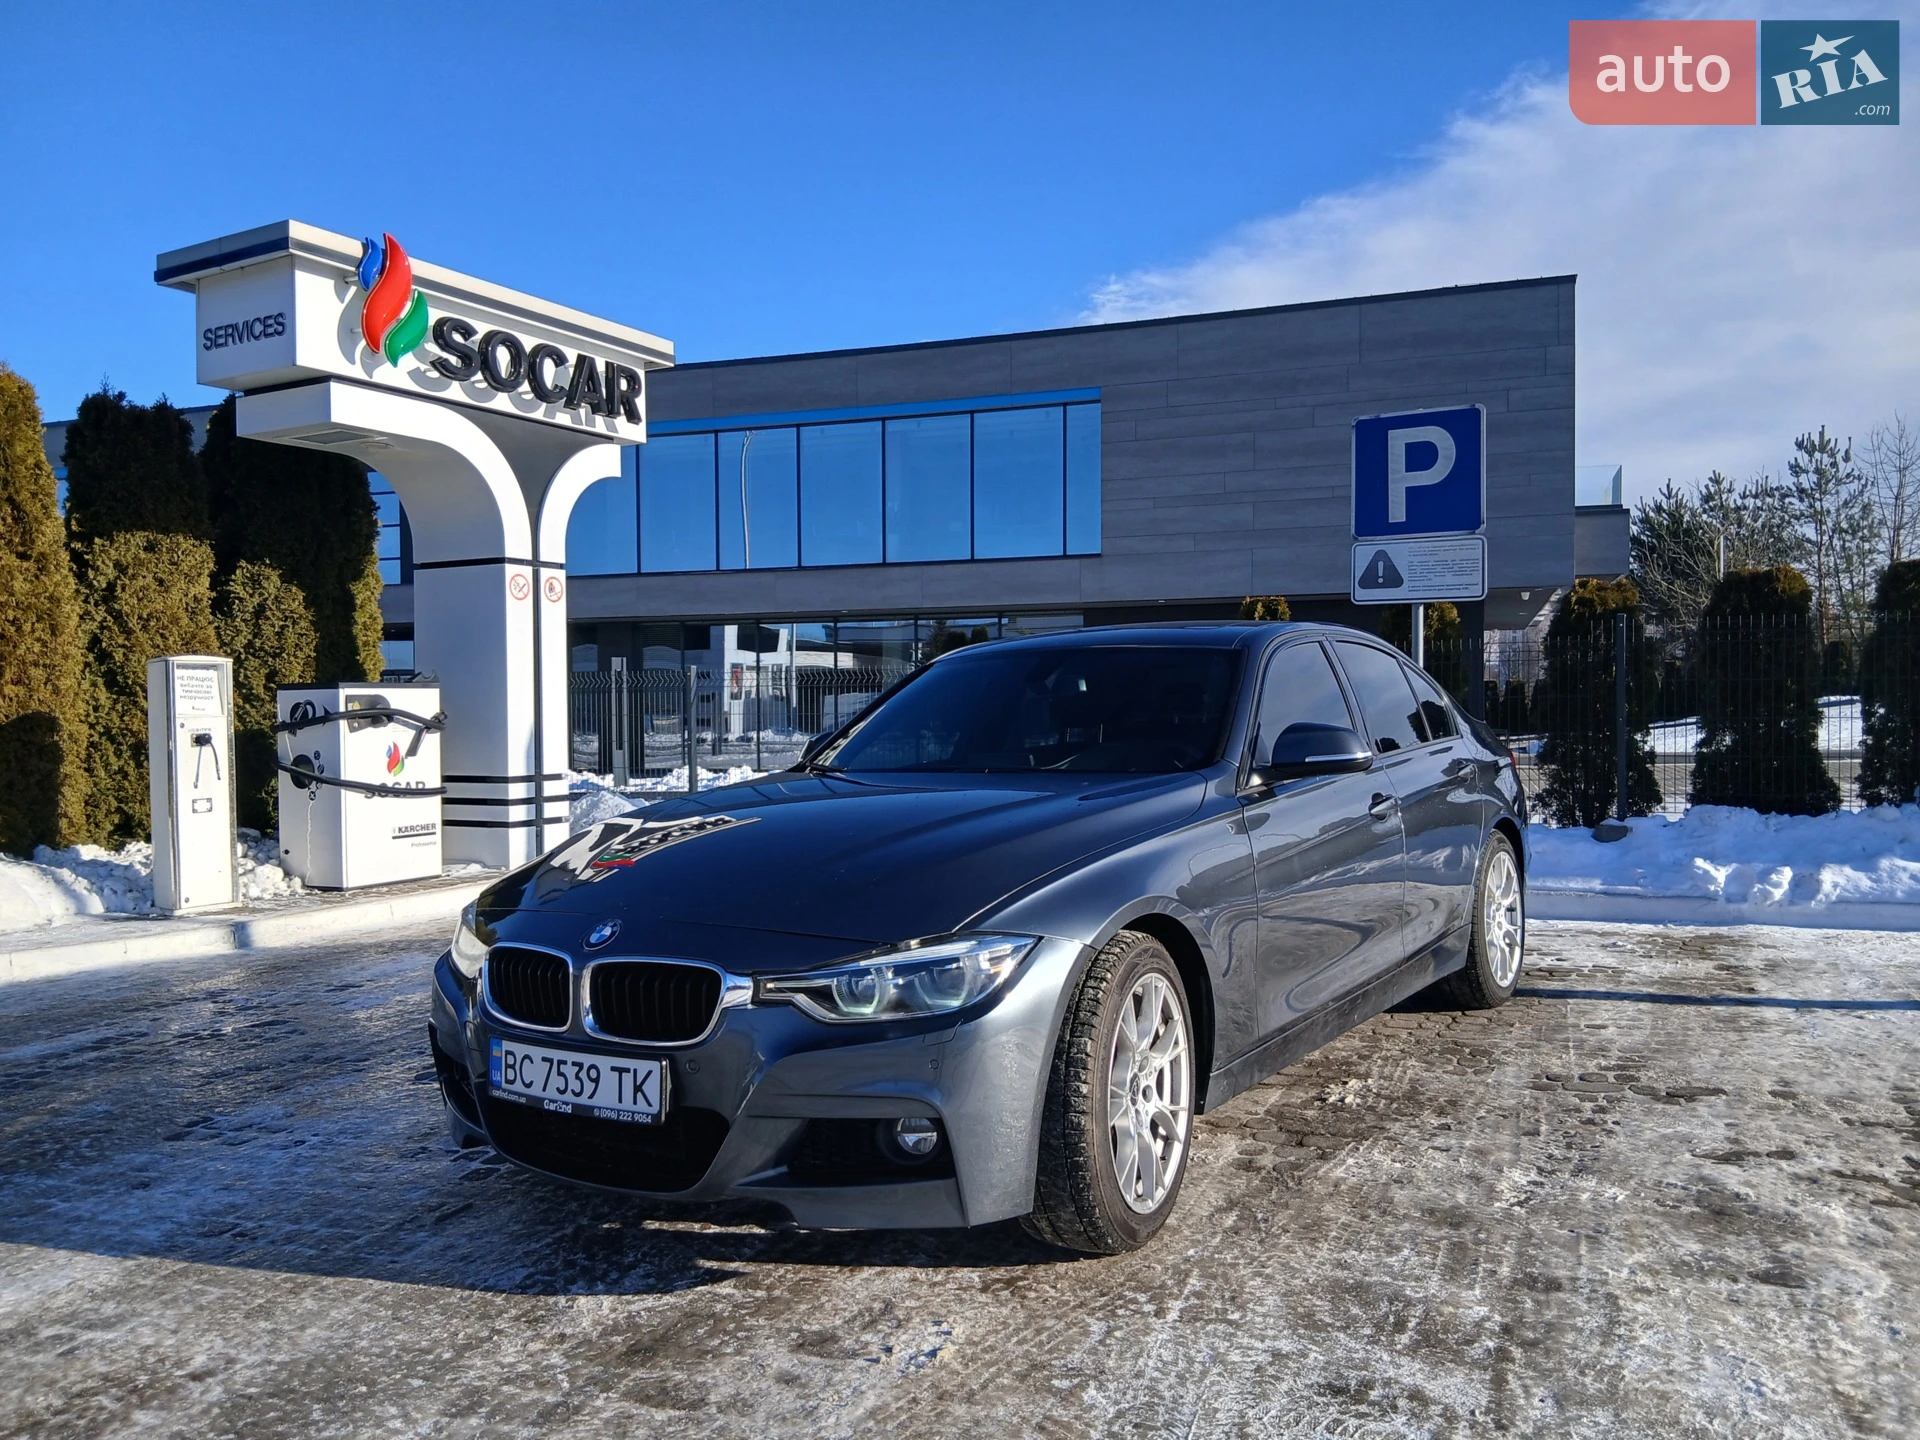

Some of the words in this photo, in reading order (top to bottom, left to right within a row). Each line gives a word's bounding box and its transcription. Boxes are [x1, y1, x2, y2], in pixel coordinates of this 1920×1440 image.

[203, 312, 287, 351] SERVICES
[428, 316, 642, 425] SOCAR
[1387, 425, 1456, 523] P
[492, 1069, 502, 1082] UA
[504, 1049, 534, 1089] BC
[541, 1056, 601, 1100] 7539
[610, 1065, 653, 1108] TK
[600, 1108, 618, 1120] (096)
[619, 1111, 632, 1121] 222
